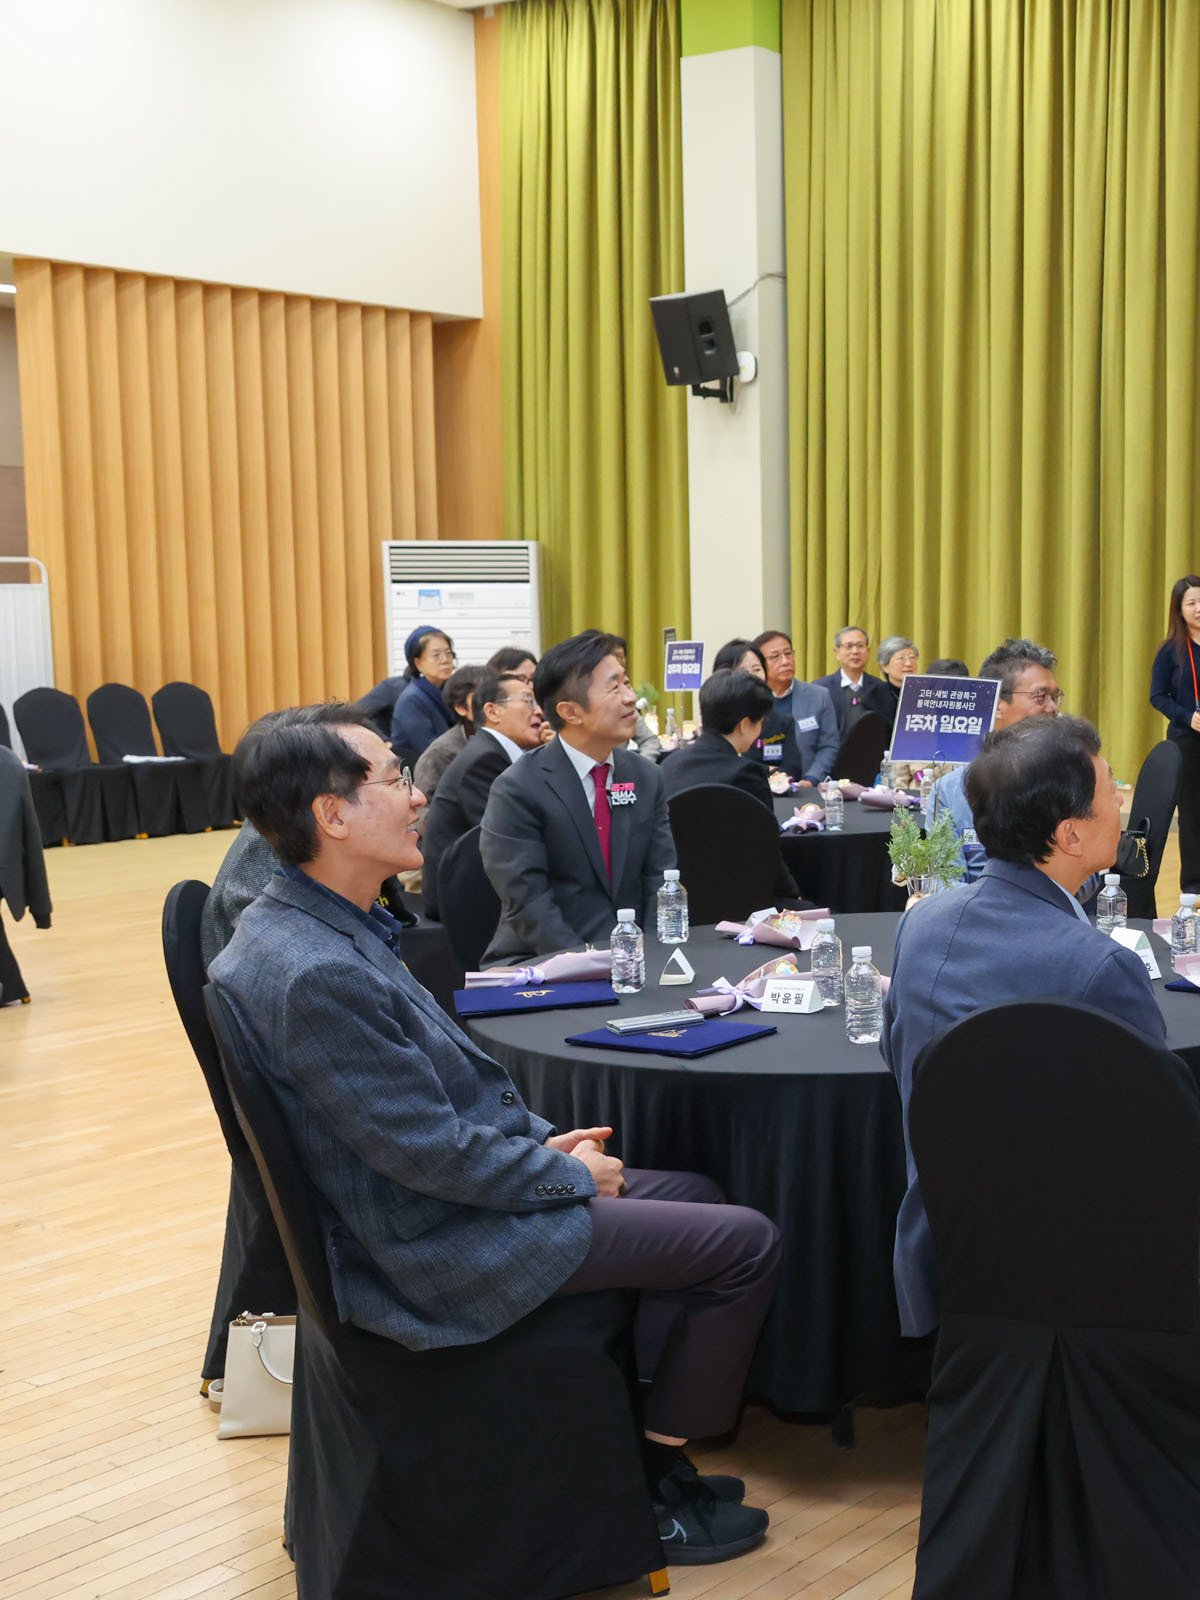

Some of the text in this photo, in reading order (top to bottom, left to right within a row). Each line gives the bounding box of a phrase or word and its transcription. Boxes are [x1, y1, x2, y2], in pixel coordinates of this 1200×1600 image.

[950, 690, 977, 700] 관광특구
[917, 699, 976, 711] 통역안내자원봉사단
[905, 714, 983, 735] 1주차 일요일
[771, 992, 804, 1005] 박윤필
